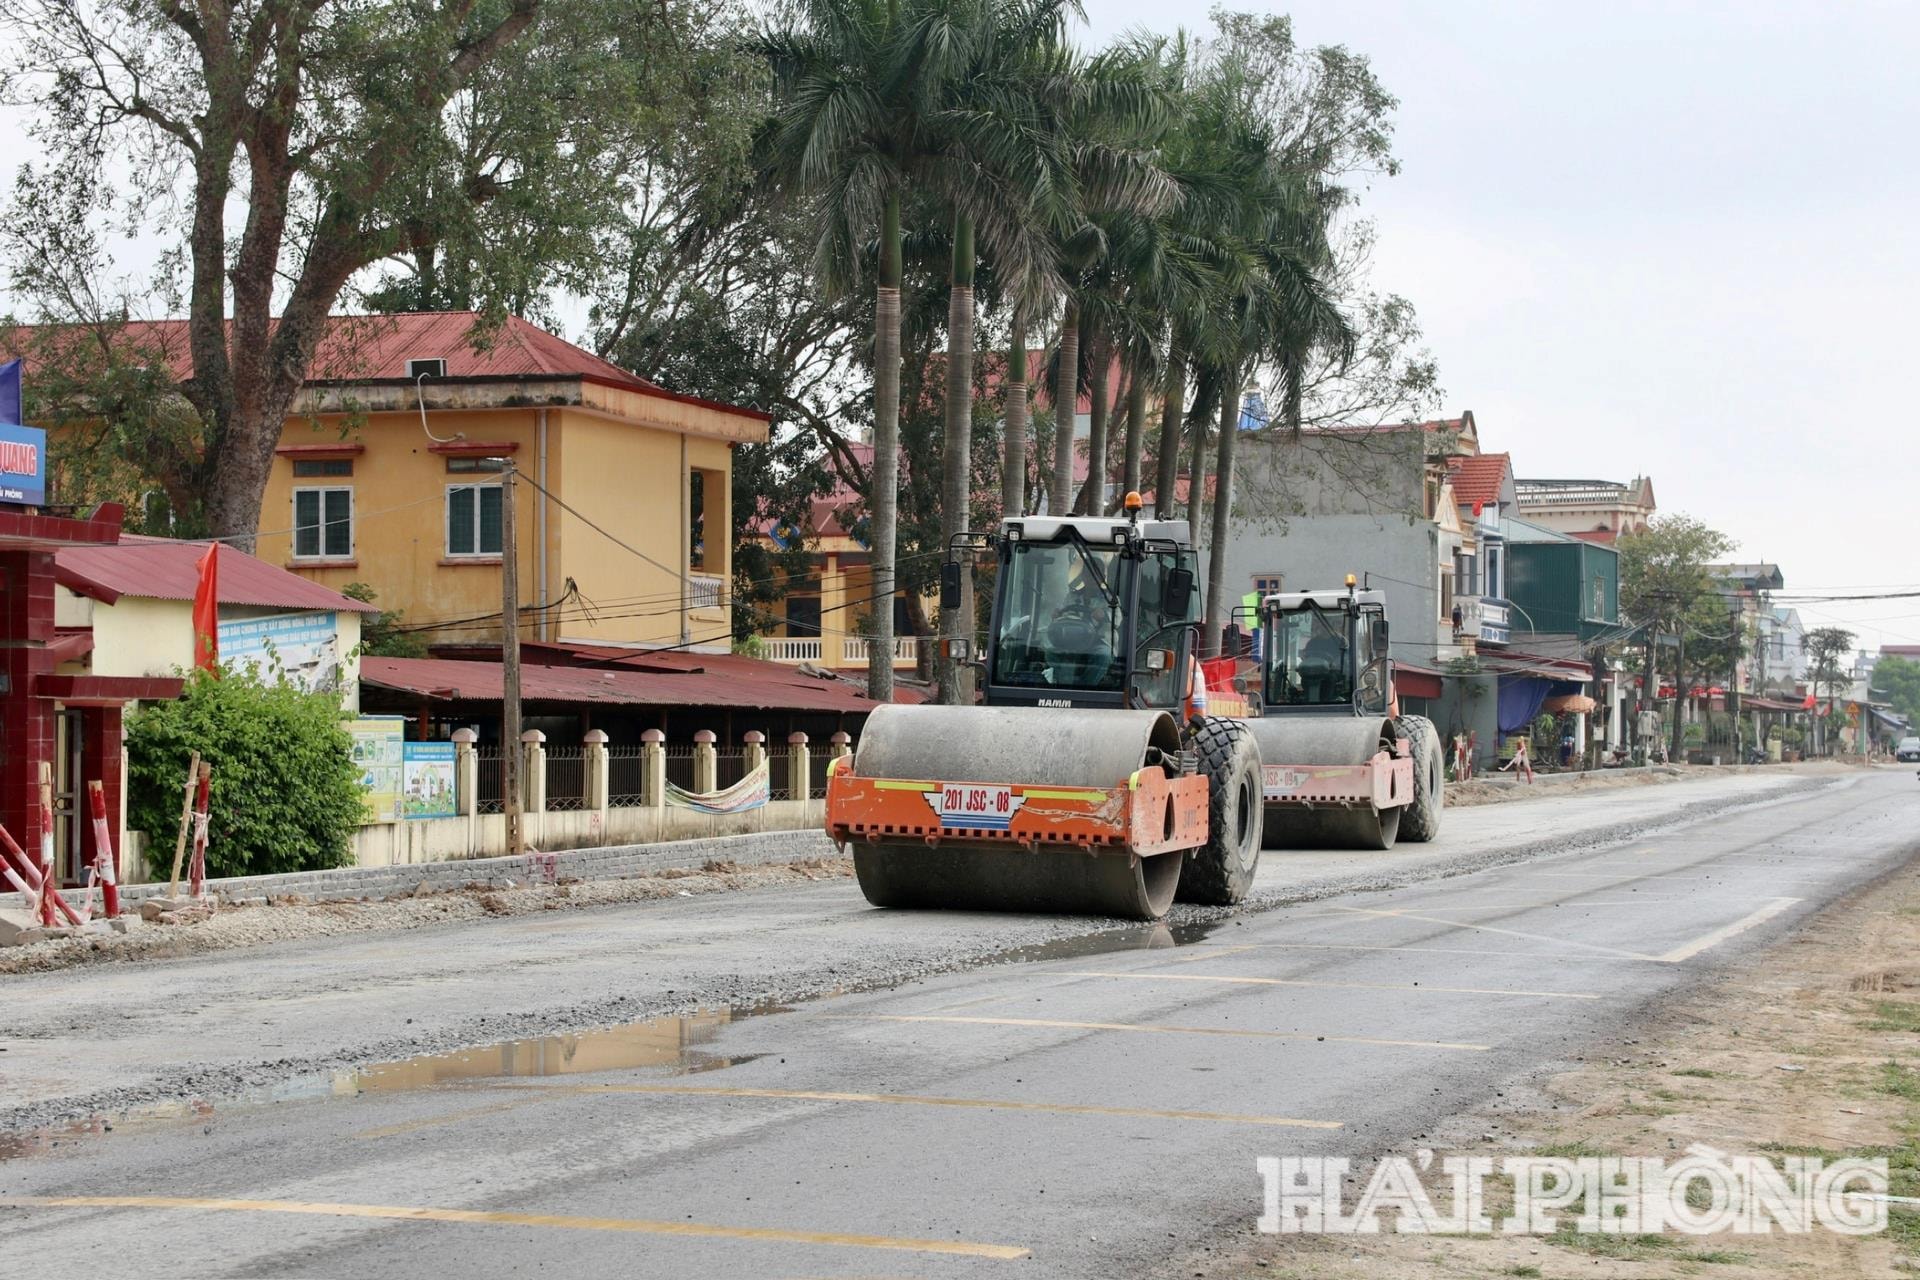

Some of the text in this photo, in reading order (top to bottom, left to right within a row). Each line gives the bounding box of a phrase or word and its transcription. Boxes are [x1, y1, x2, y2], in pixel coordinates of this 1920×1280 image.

[1038, 698, 1072, 708] HAMM
[944, 788, 963, 810] 201
[966, 789, 987, 811] JSC
[996, 791, 1010, 812] 08
